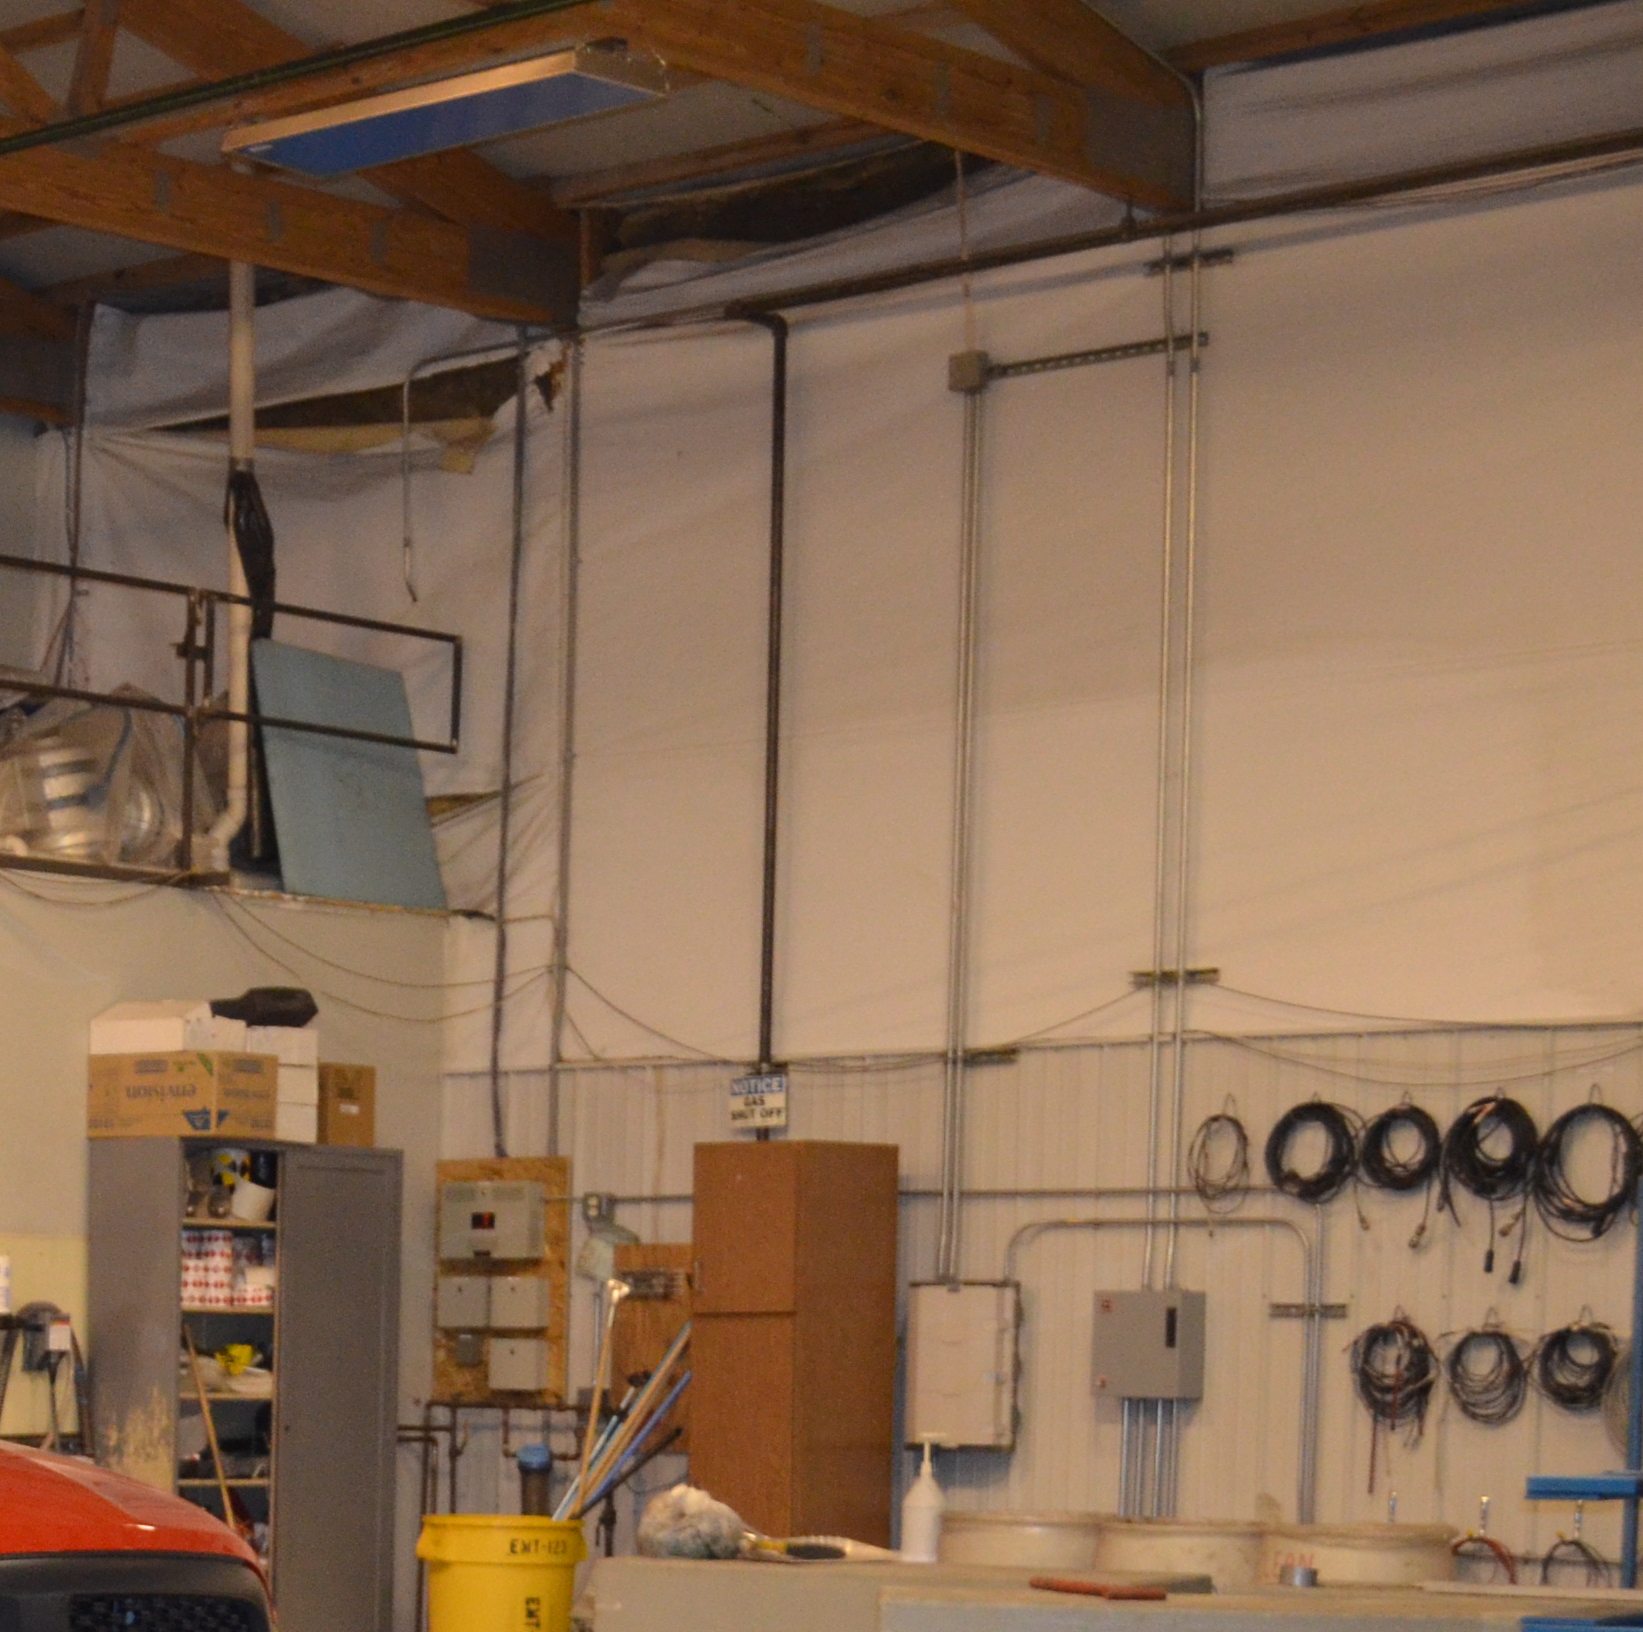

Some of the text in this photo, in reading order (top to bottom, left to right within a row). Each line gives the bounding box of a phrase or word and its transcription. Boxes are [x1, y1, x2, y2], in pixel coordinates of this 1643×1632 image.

[126, 1084, 197, 1101] envision
[731, 1076, 785, 1096] NOTICE
[743, 1095, 766, 1107] GAS
